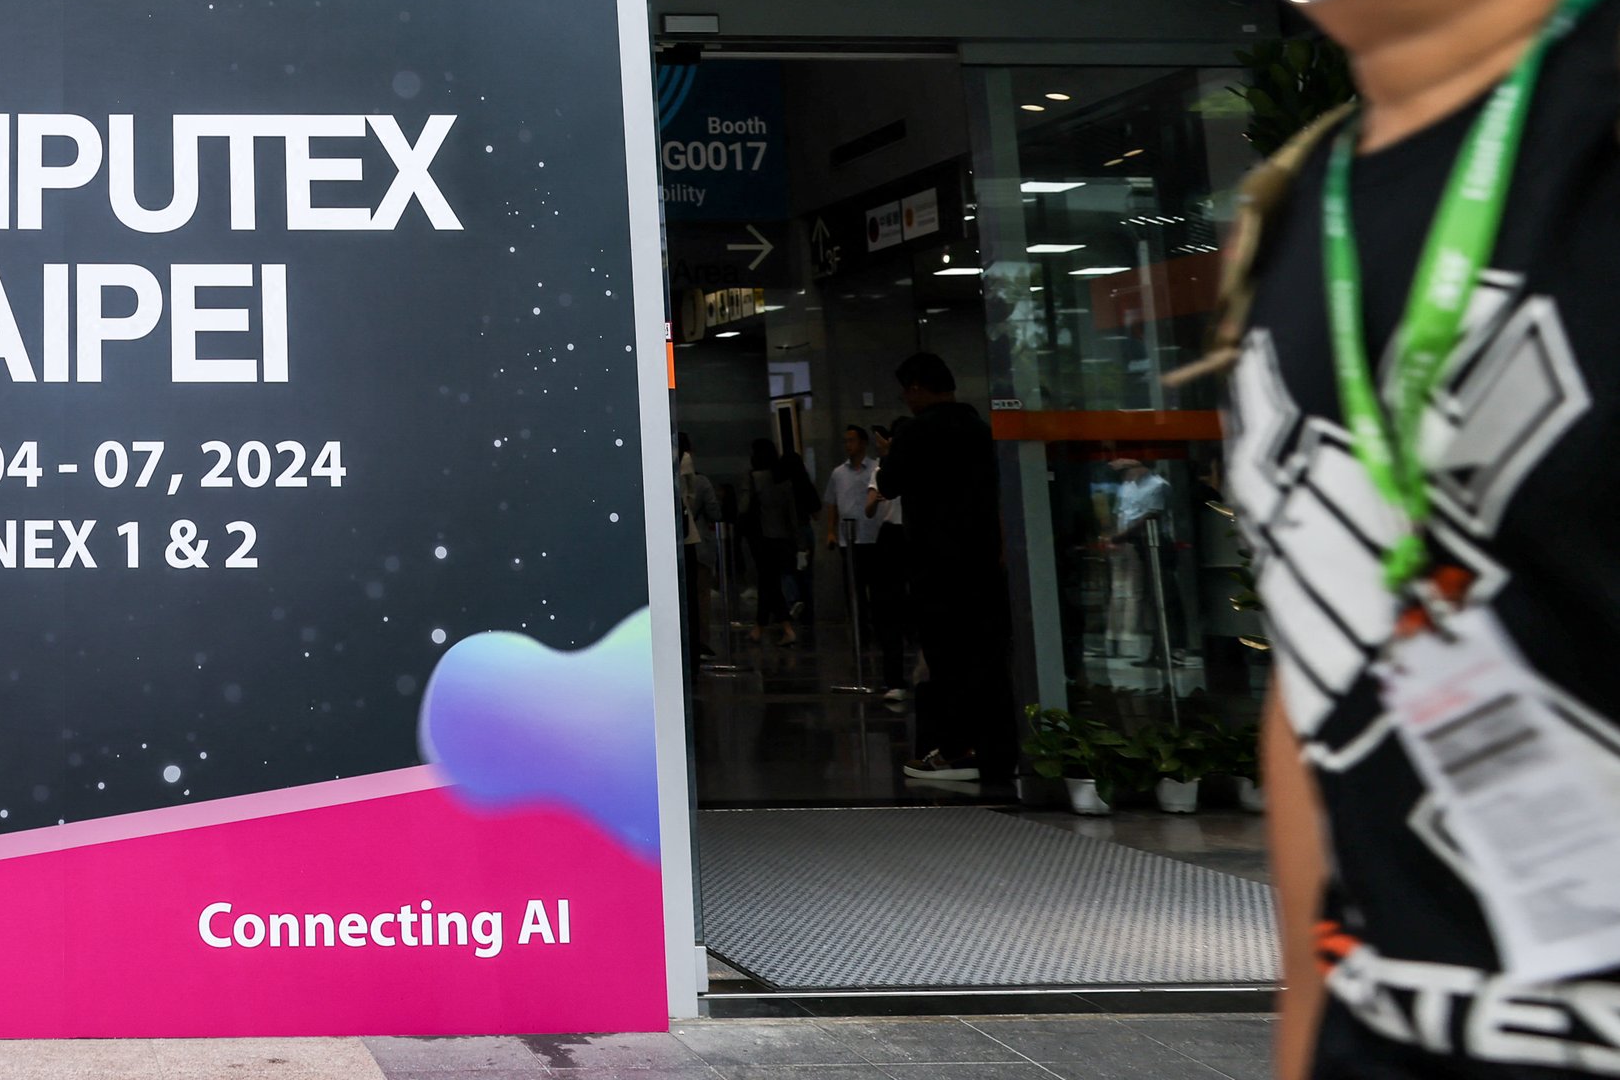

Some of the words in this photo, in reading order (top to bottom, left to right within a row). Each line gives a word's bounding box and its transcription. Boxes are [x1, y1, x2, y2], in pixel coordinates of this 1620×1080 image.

[707, 116, 767, 135] Booth
[662, 141, 767, 171] G0017
[58, 464, 78, 473] -
[93, 440, 183, 496] 07,
[200, 440, 347, 488] 2024
[116, 520, 139, 569] 1
[164, 519, 210, 569] &
[225, 520, 259, 568] 2
[198, 899, 503, 958] Connecting
[517, 899, 570, 945] AI
